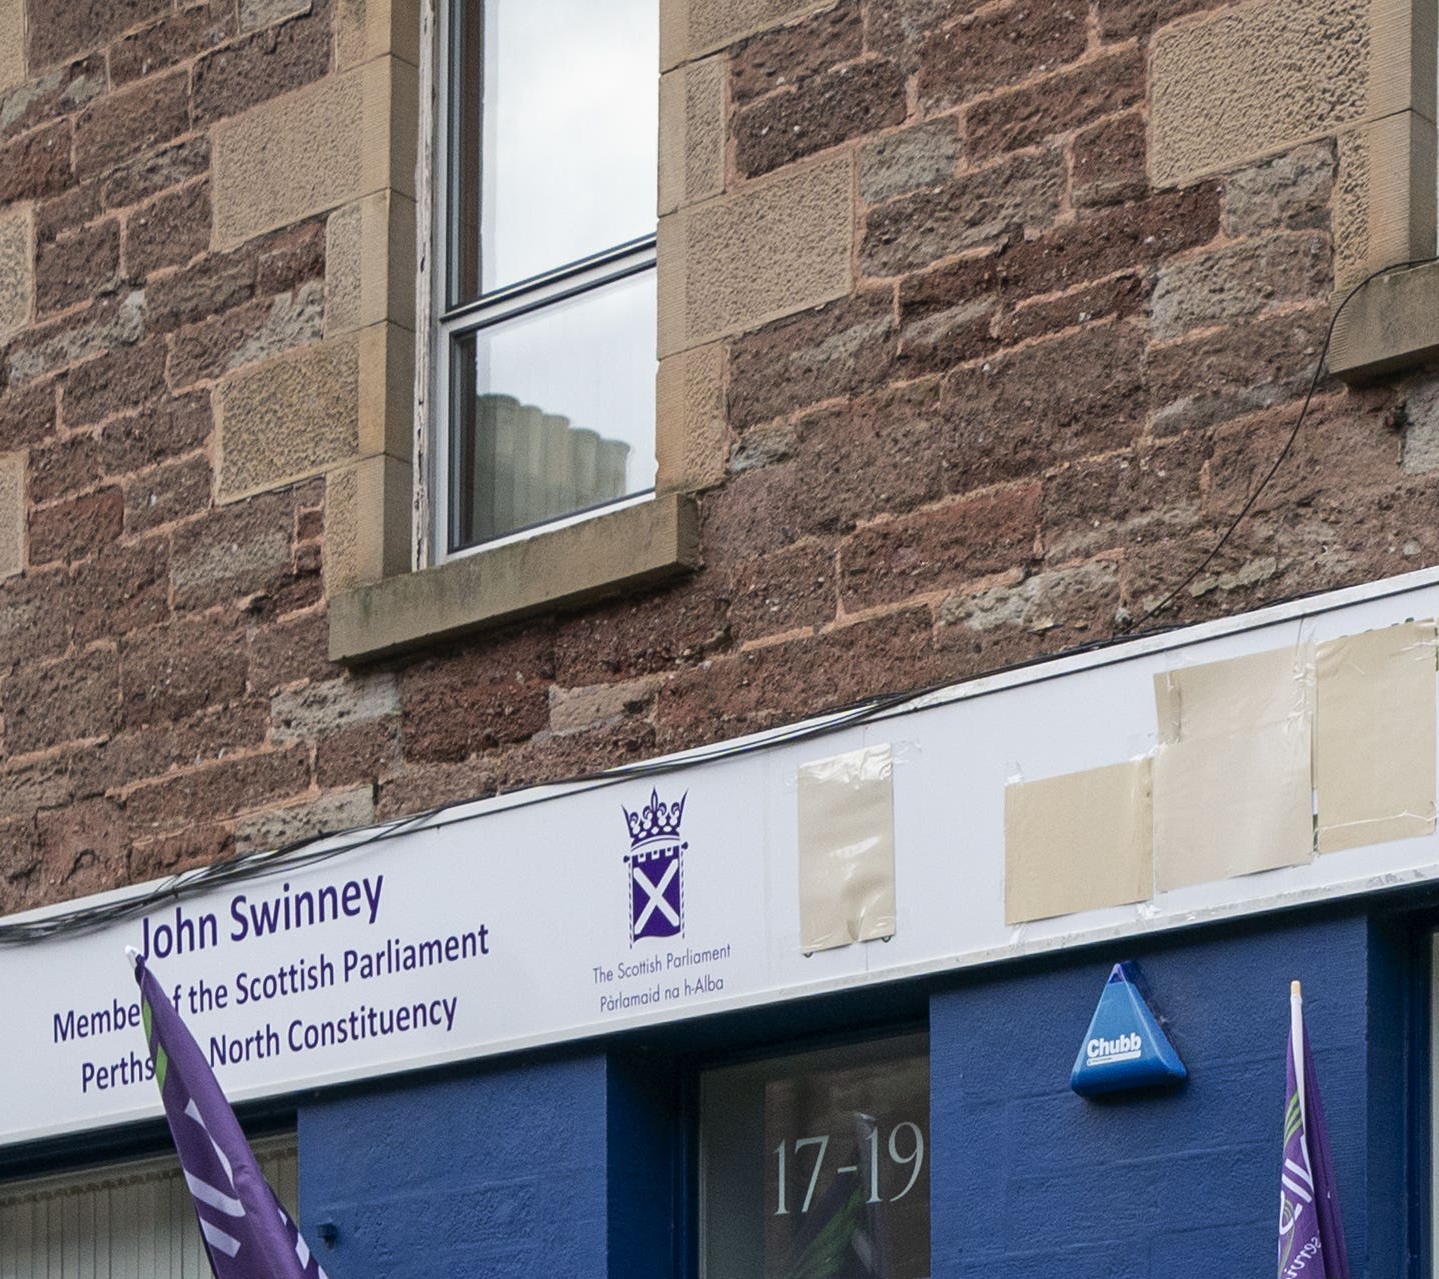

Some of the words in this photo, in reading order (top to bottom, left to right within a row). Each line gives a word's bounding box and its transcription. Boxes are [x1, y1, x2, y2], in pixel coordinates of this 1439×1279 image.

[142, 907, 218, 961] John
[231, 874, 384, 942] Swinney
[53, 998, 141, 1044] Membe
[169, 984, 182, 1016] f
[188, 979, 228, 1015] the
[236, 954, 335, 1005] Scottish
[344, 923, 489, 983] Parliament
[592, 965, 614, 985] The
[618, 956, 662, 980] Scottish
[666, 943, 731, 968] Parliament
[665, 985, 680, 1000] na
[684, 975, 724, 997] h-Alba
[81, 1051, 156, 1093] Perths
[209, 1023, 280, 1068] North
[287, 996, 458, 1052] Constituency
[1087, 1032, 1142, 1058] Chubb
[773, 1121, 925, 1216] 17-19
